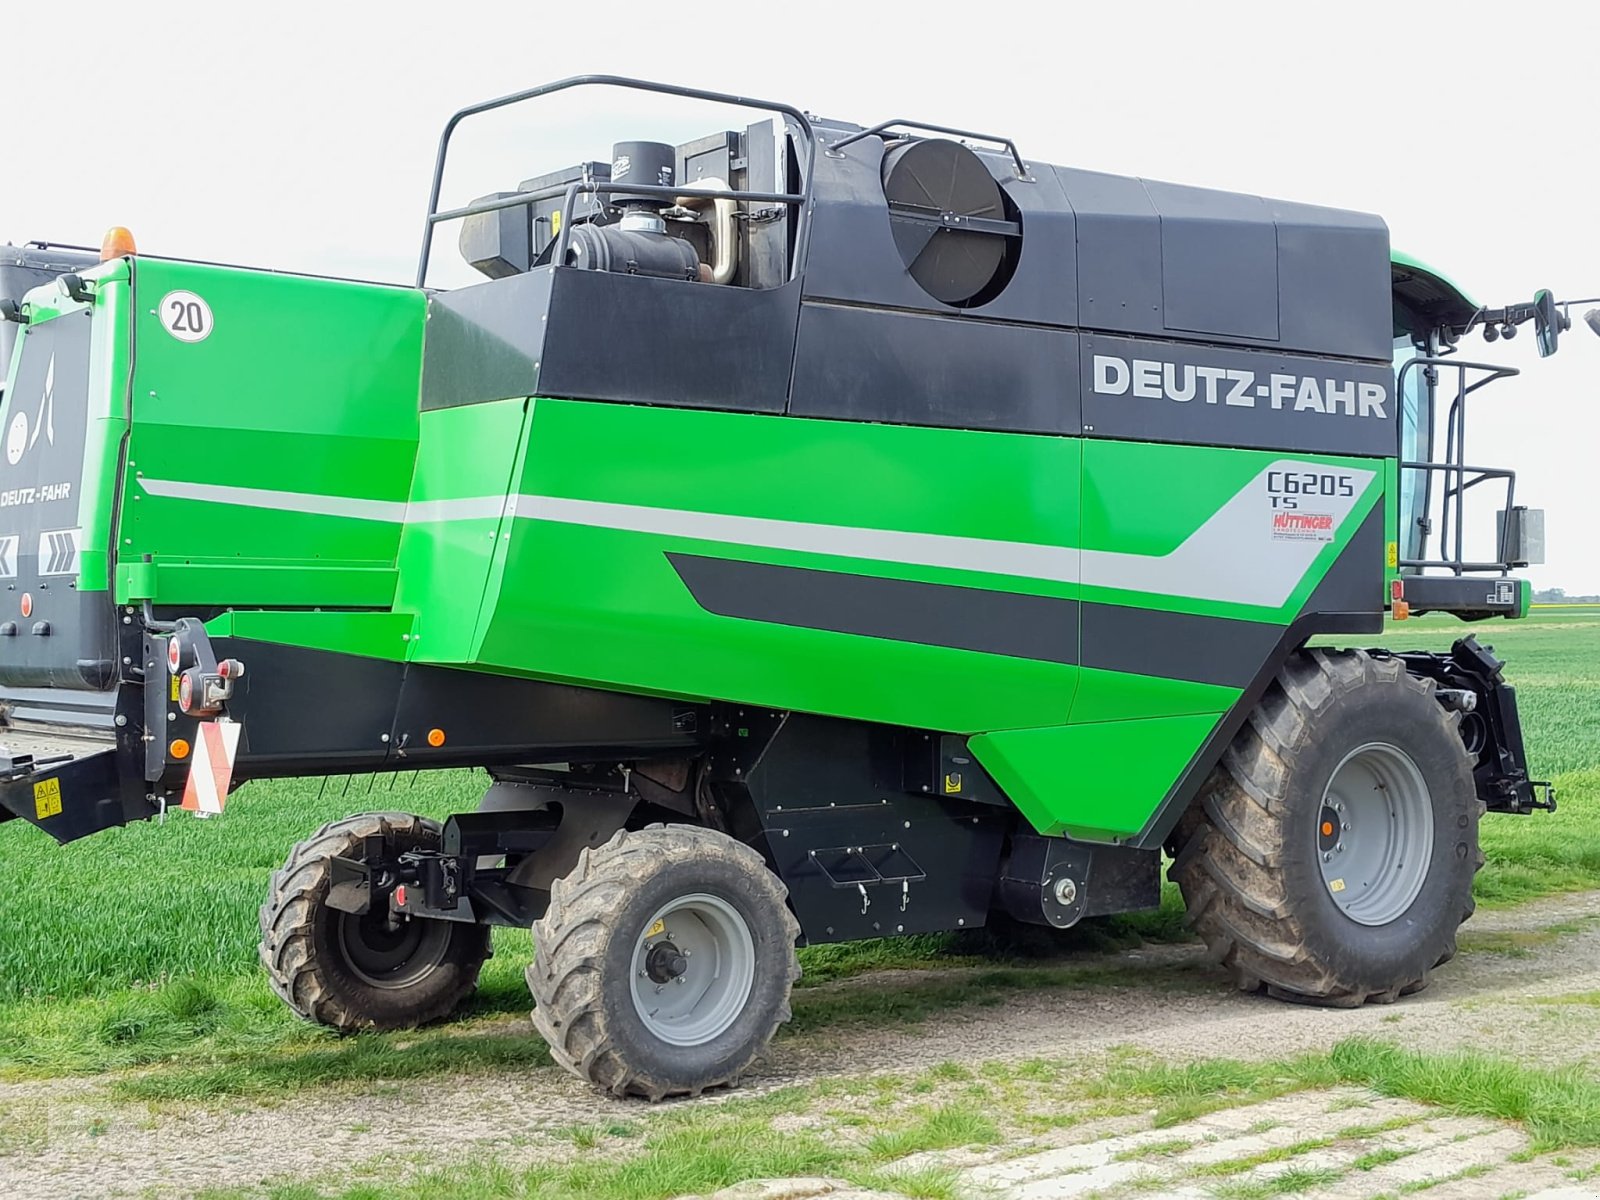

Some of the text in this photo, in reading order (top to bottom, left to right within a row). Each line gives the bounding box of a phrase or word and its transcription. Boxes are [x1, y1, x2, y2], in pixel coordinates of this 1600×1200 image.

[171, 300, 204, 333] 20
[1093, 354, 1388, 419] DEUTZ-FAHR
[0, 482, 71, 507] DEUTZ-FAHR
[1267, 471, 1354, 497] C6205
[1268, 495, 1298, 509] TS
